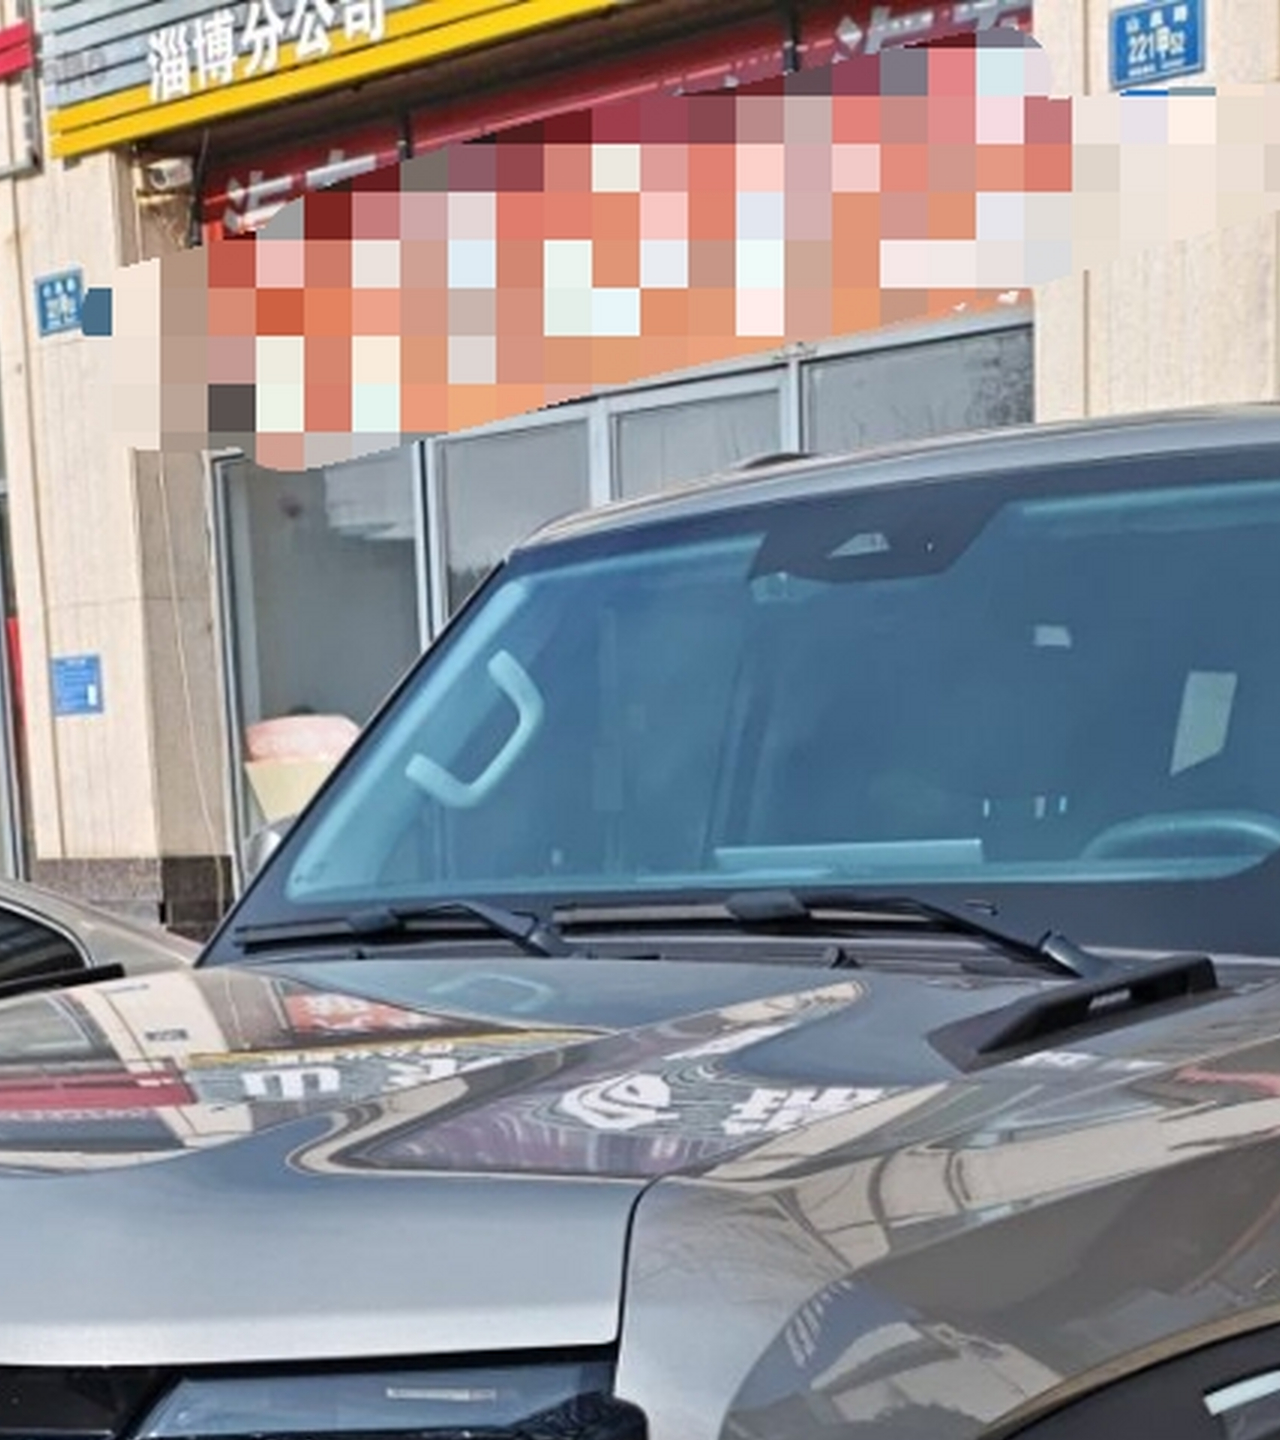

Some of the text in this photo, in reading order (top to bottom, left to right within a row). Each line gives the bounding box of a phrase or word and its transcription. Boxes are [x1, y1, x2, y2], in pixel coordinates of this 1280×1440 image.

[148, 0, 386, 103] 淄博分公司
